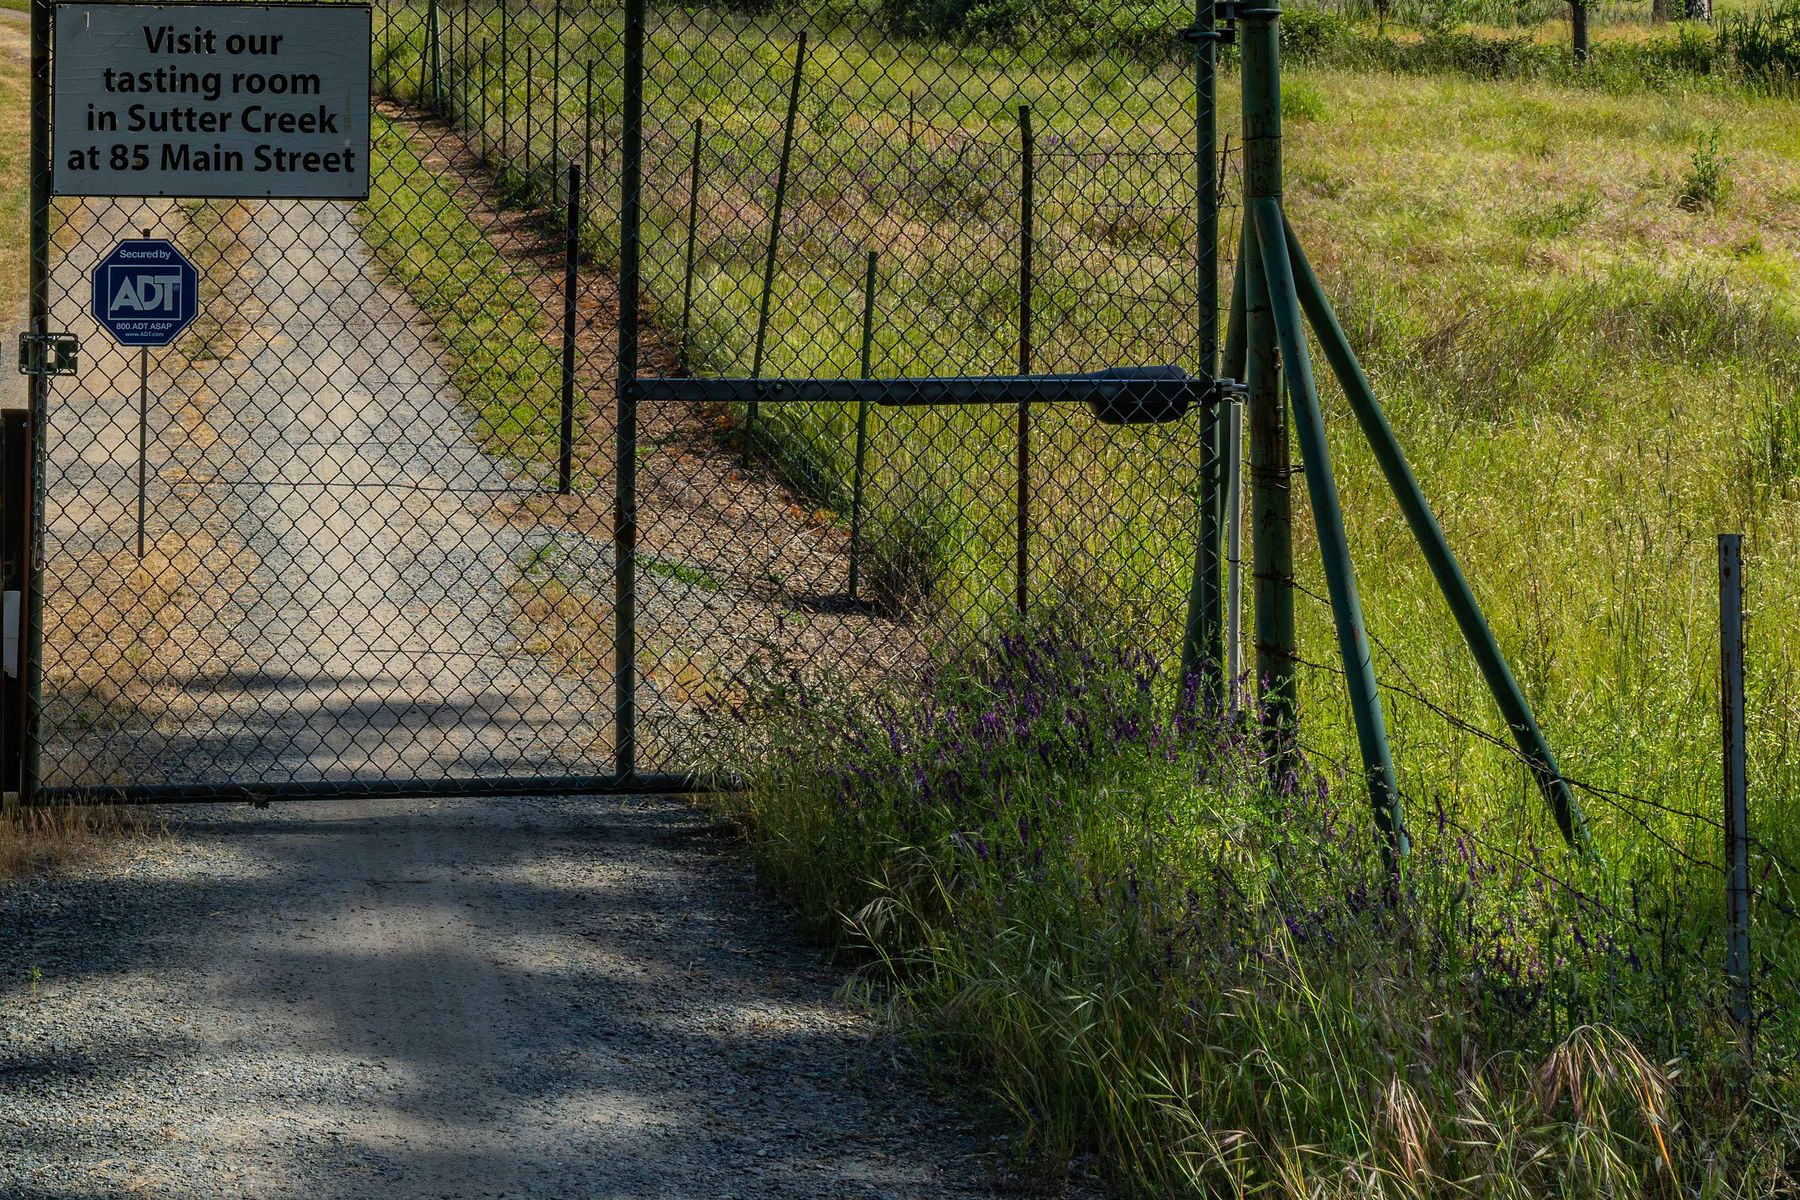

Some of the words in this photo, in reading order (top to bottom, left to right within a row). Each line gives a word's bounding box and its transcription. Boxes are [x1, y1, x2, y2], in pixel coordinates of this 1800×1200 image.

[143, 25, 217, 55] Visit
[225, 34, 283, 55] our
[104, 65, 221, 100] tasting
[232, 72, 321, 94] room
[87, 103, 117, 131] in
[128, 104, 232, 132] Sutter
[241, 105, 338, 133] Creek
[67, 145, 100, 171] at
[109, 144, 149, 171] 85
[160, 144, 243, 171] Main
[254, 144, 355, 173] Street
[119, 249, 158, 259] Secured
[159, 249, 171, 260] by
[110, 275, 181, 311] ADT
[116, 322, 172, 330] 800.ADT.ASAP
